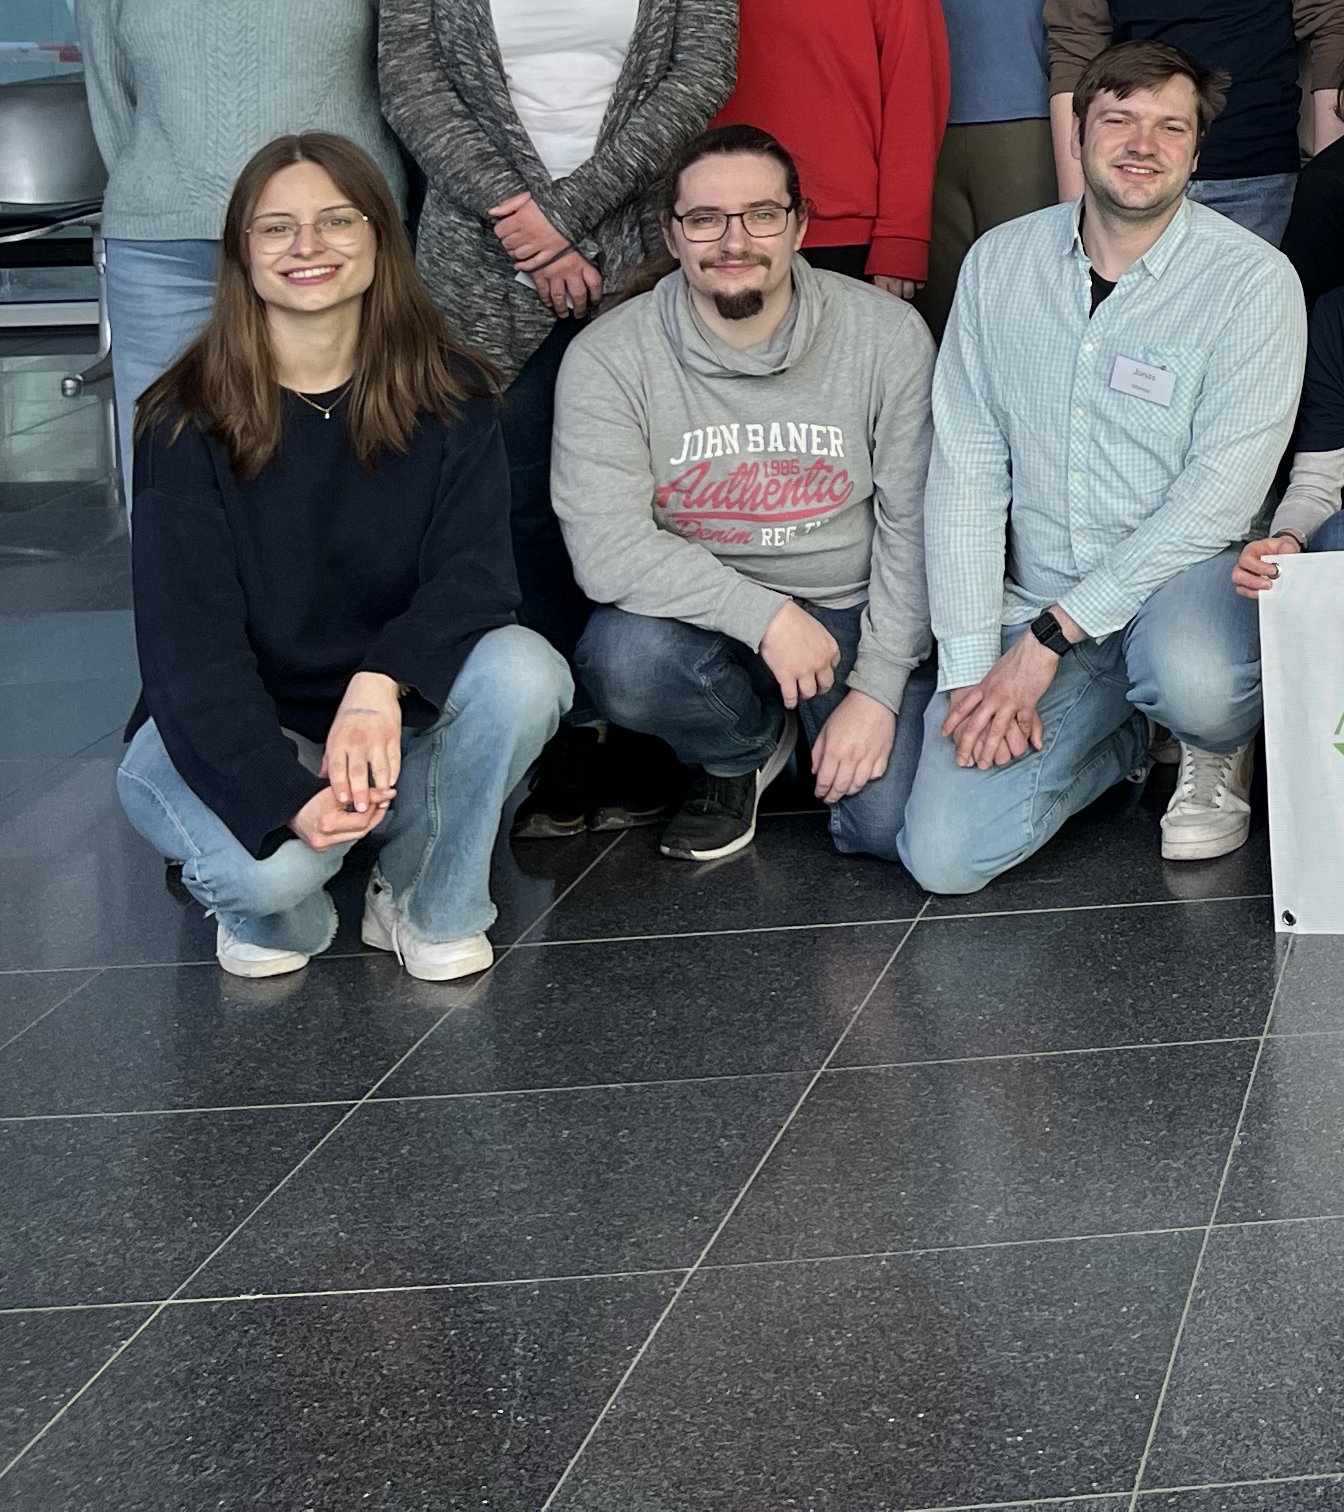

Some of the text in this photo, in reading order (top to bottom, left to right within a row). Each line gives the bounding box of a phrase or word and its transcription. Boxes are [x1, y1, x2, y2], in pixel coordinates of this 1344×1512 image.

[669, 421, 845, 466] JOHN BANER
[653, 456, 855, 511] Authentic
[676, 519, 754, 544] Denim
